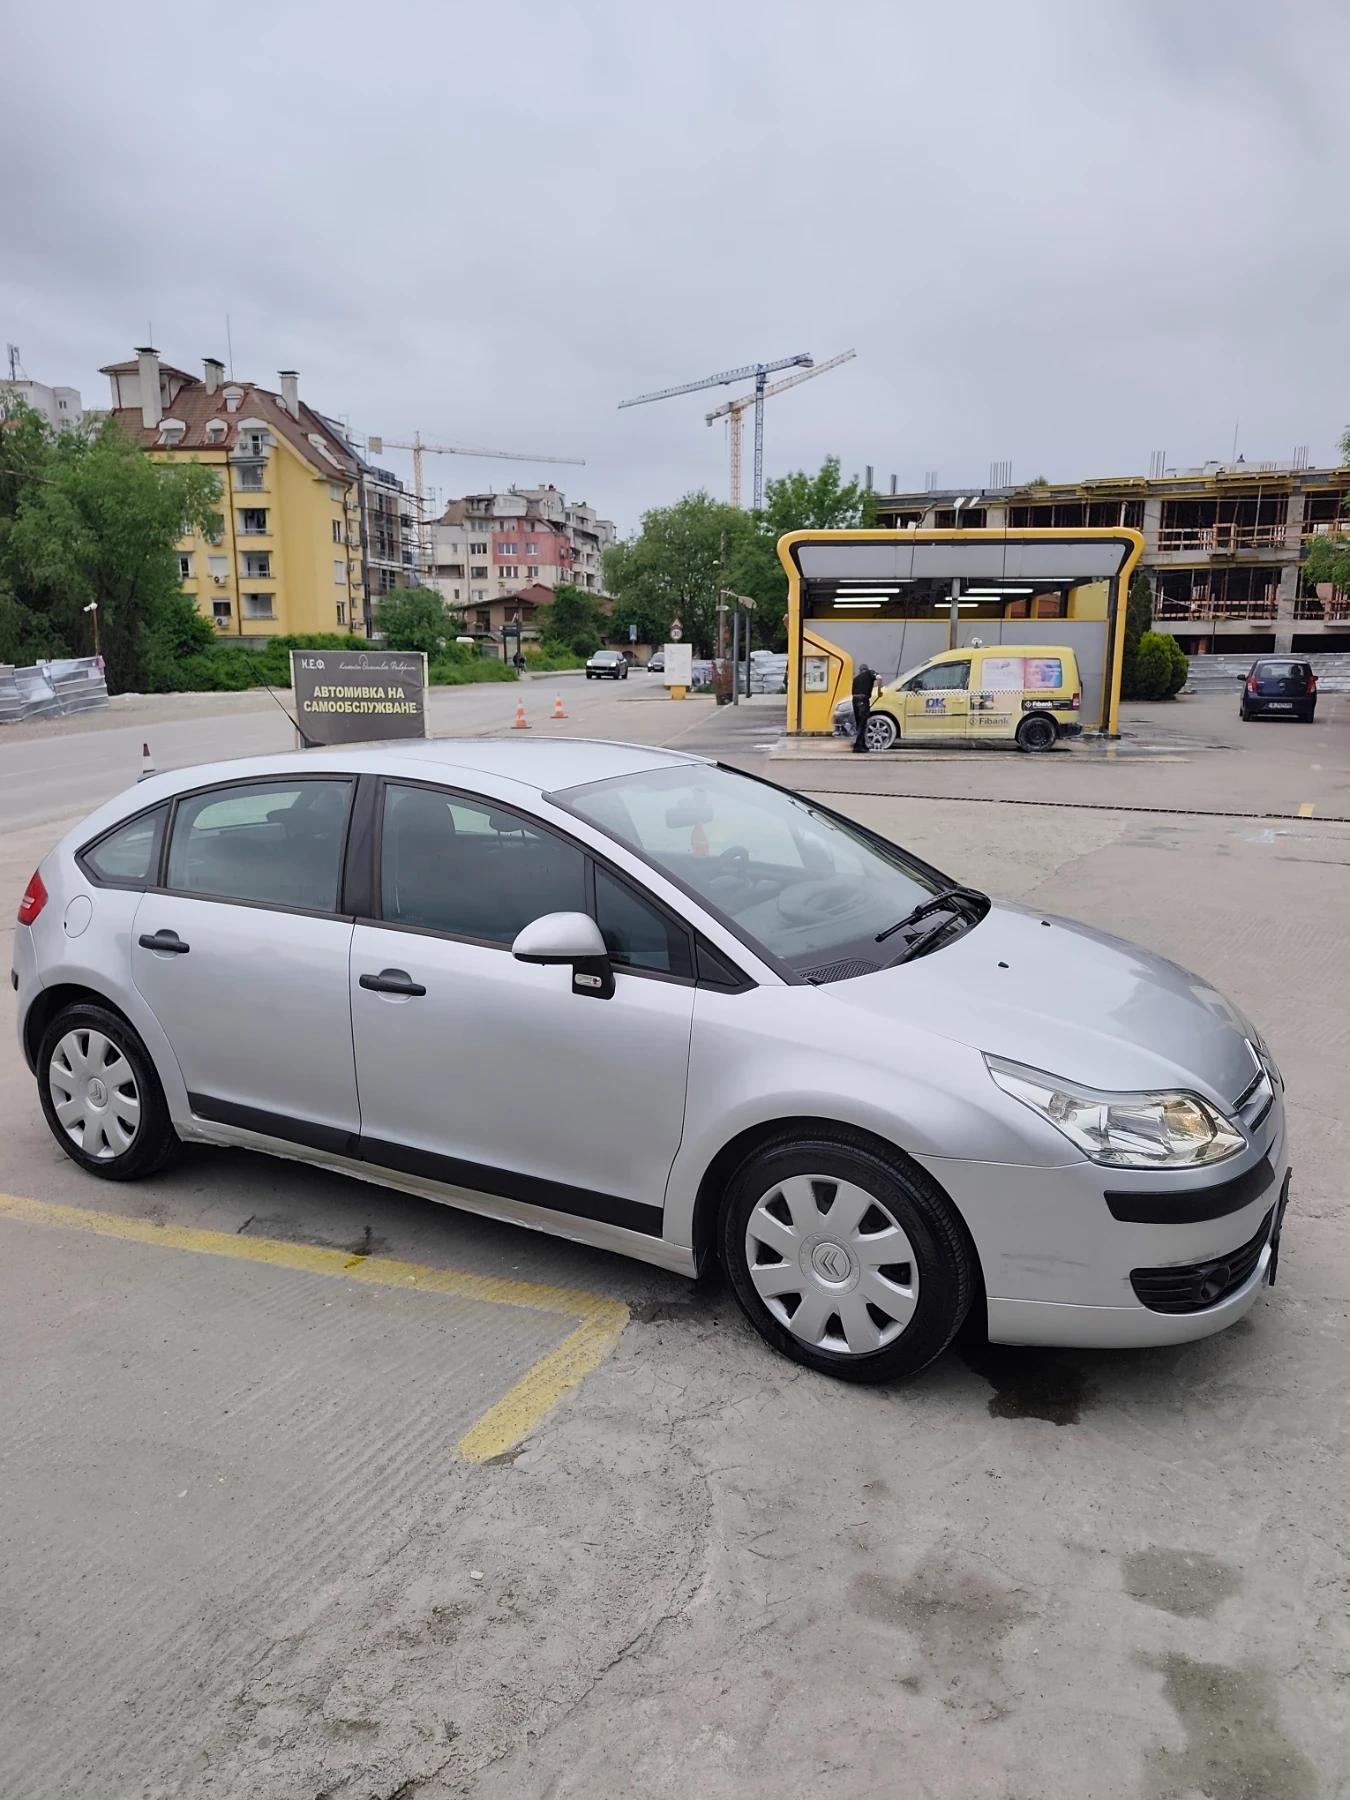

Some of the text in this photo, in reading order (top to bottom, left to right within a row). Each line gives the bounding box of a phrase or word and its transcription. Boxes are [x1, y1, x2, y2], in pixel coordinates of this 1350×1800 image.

[313, 686, 405, 699] АВТОМИВКА НА
[303, 701, 417, 714] САМООБСЛУЖВАНЕ
[979, 717, 1009, 725] Fibank
